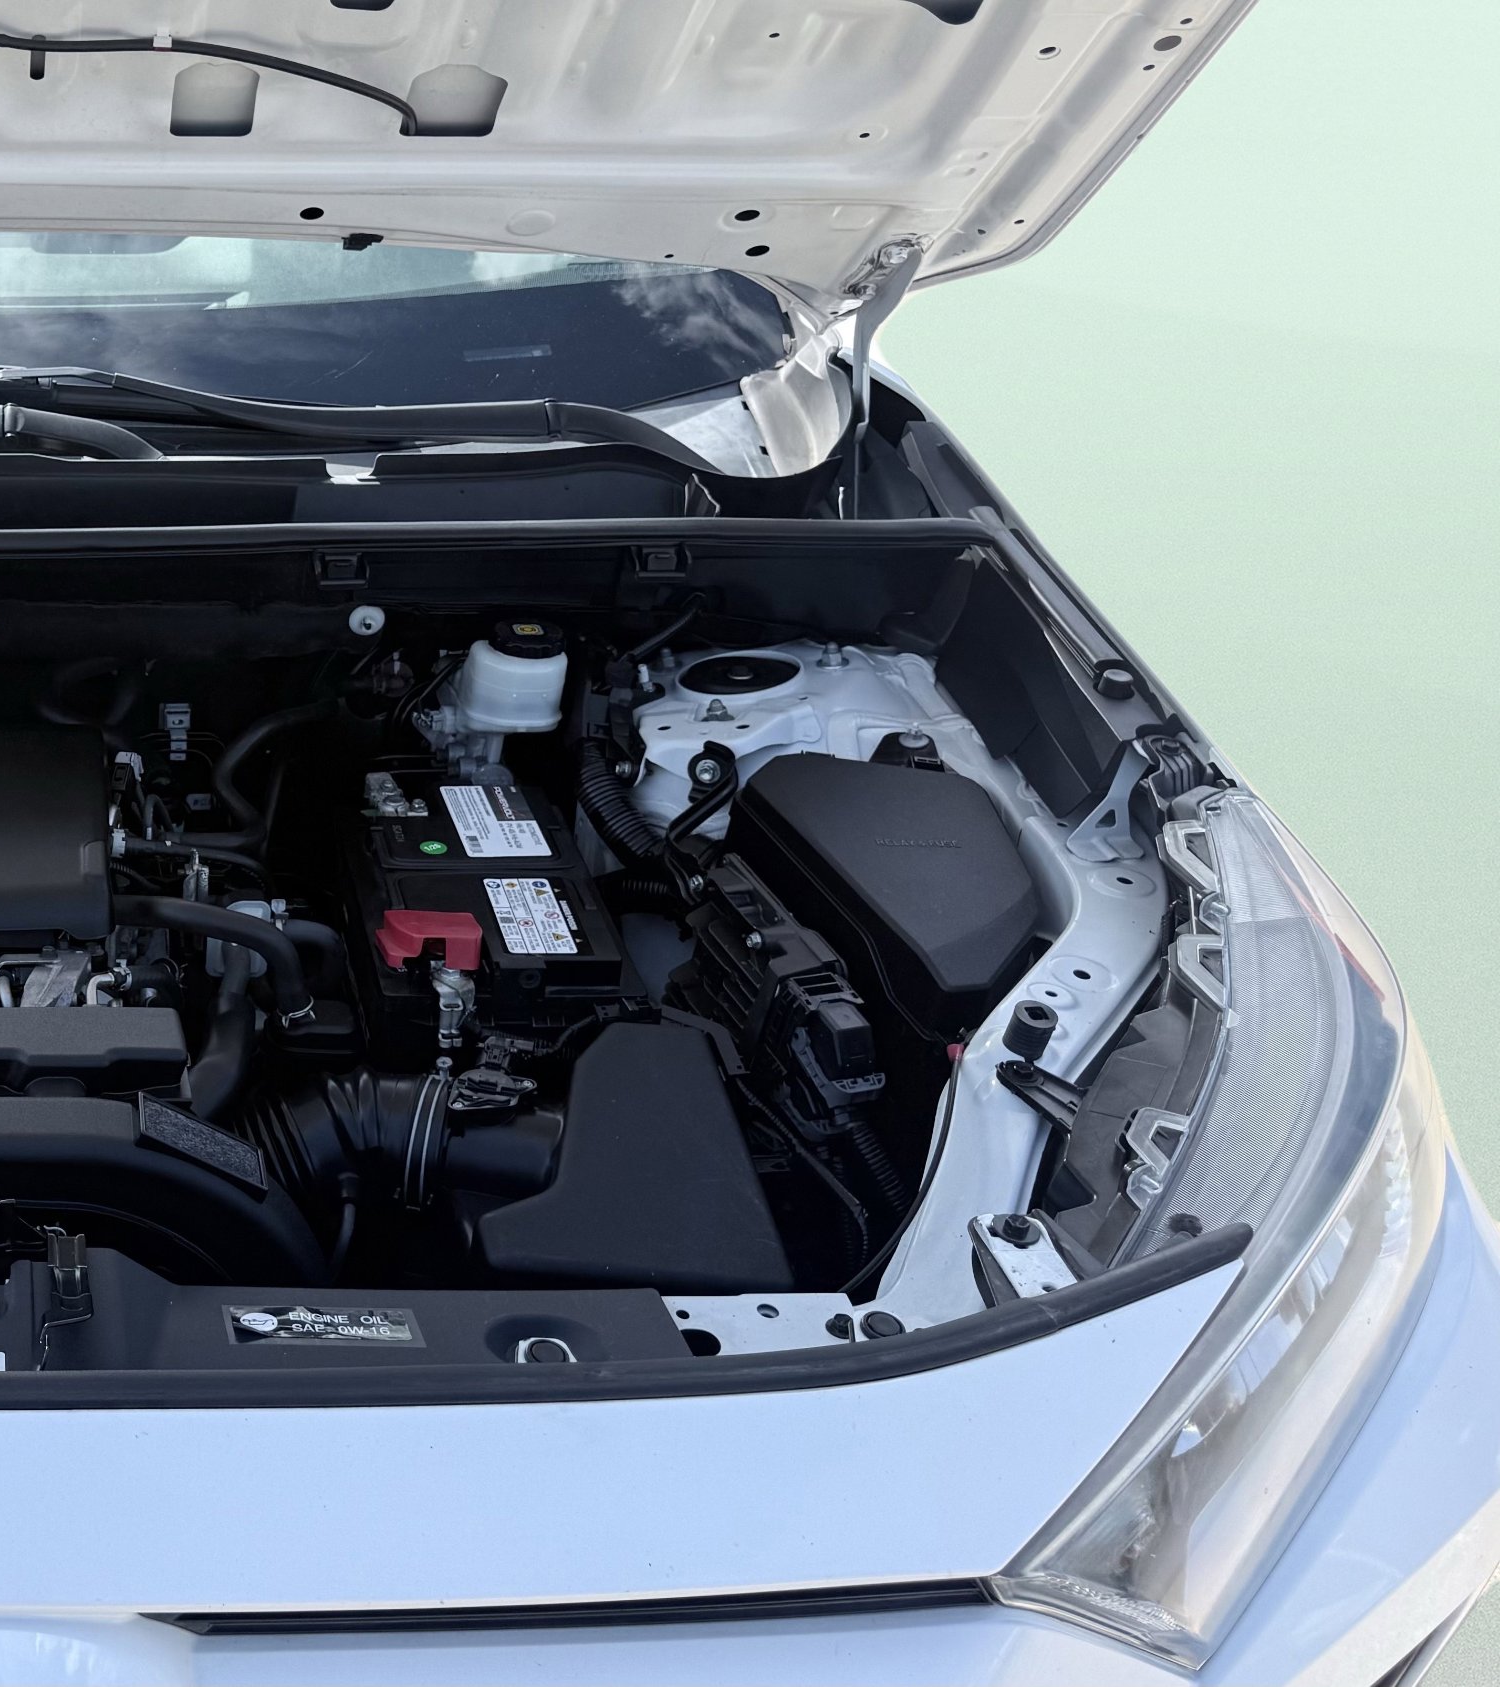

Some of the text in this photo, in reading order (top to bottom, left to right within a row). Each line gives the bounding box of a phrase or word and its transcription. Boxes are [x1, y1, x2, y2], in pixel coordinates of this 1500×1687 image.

[288, 1311, 388, 1325] ENGINE OIL
[292, 1323, 390, 1336] SAE 0W-16
